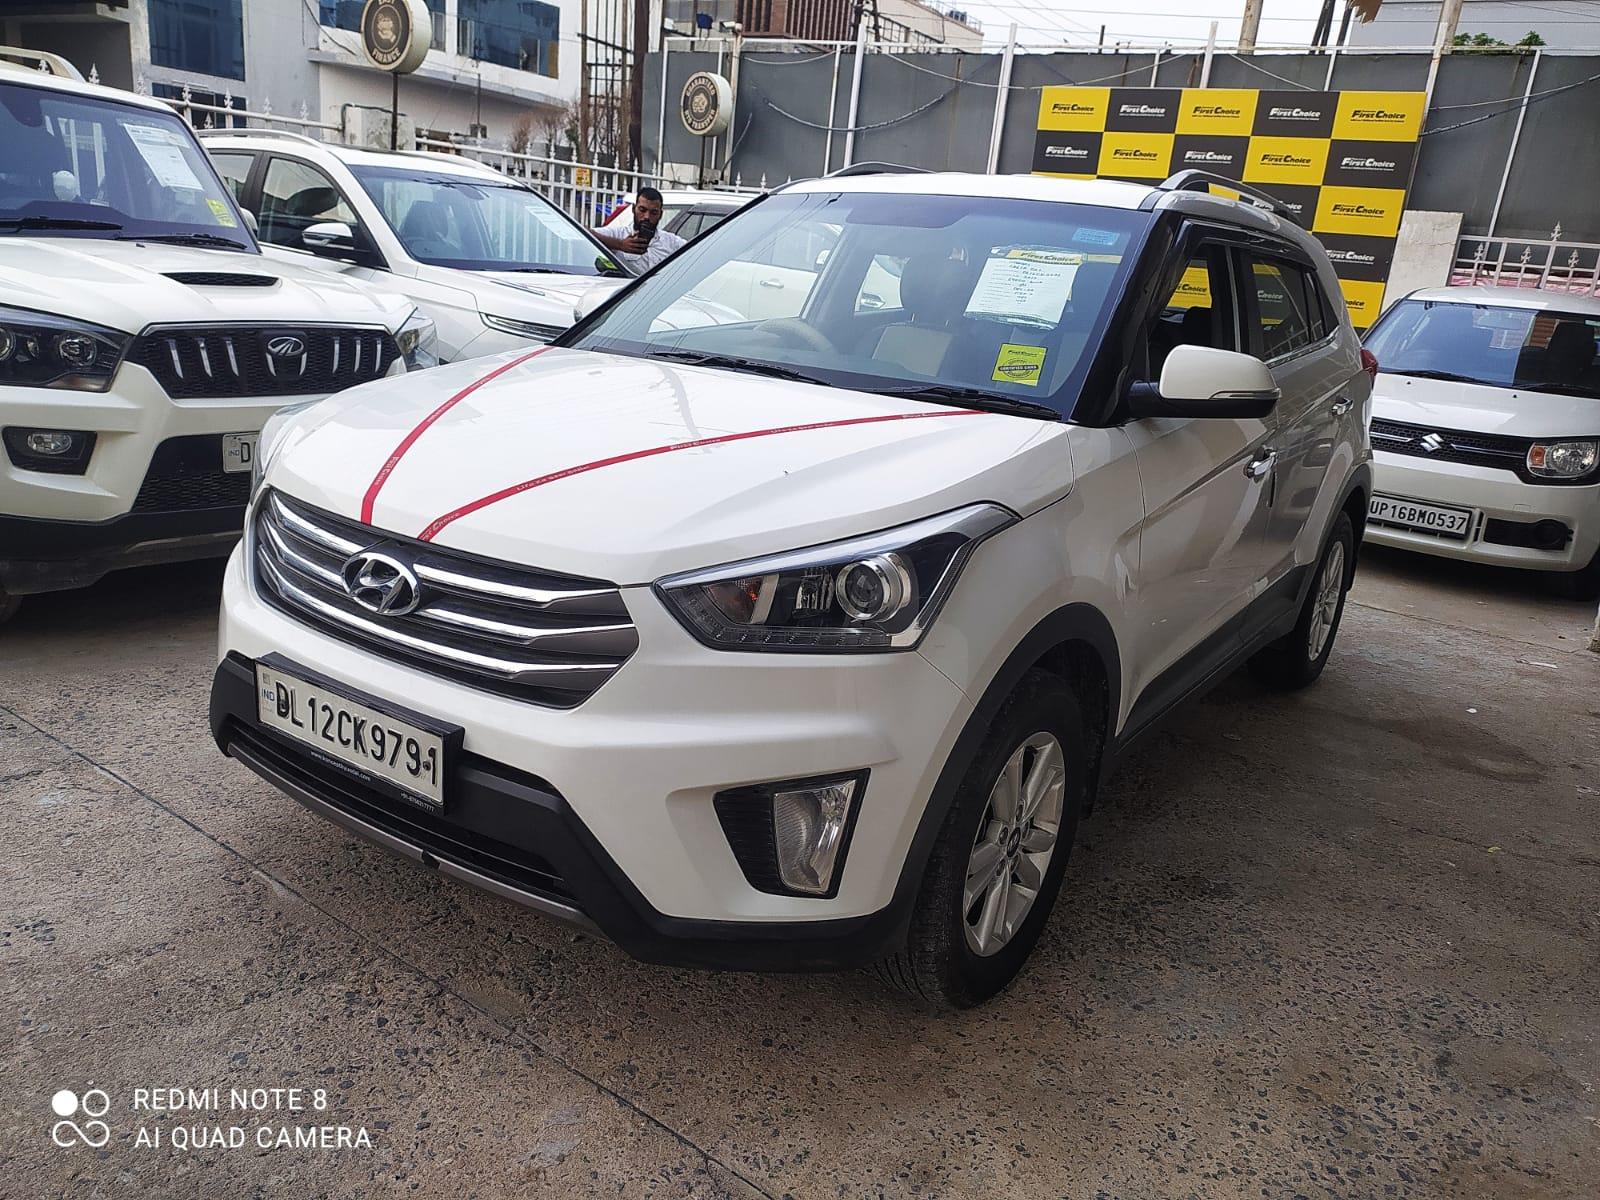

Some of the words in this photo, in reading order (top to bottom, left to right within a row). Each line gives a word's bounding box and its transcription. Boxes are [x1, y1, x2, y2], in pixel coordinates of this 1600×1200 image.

[1052, 103, 1070, 111] First
[1071, 104, 1094, 112] Choice
[1120, 104, 1140, 113] First
[1140, 105, 1166, 114] Choice
[1193, 106, 1213, 114] First
[1213, 107, 1241, 115] Choice
[1269, 107, 1293, 116] First
[1293, 108, 1321, 117] Choice
[1351, 110, 1376, 119] First
[1376, 111, 1406, 119] Choice
[1045, 146, 1065, 154] First
[1065, 147, 1089, 155] Choice
[1113, 149, 1133, 157] First
[1133, 150, 1158, 158] Choice
[1184, 151, 1207, 159] First
[1207, 151, 1233, 161] Choice
[1261, 154, 1284, 163] First
[1284, 155, 1312, 164] Choice
[1341, 157, 1366, 167] First
[1366, 158, 1396, 168] Choice
[1332, 204, 1356, 212] First
[1355, 205, 1385, 215] Choice
[1345, 251, 1375, 261] Choice
[1182, 283, 1207, 293] Choice
[1257, 290, 1284, 299] Choice
[1370, 501, 1466, 530] UP16BM0537
[261, 688, 275, 701] IND
[275, 681, 437, 785] DL12CK9791
